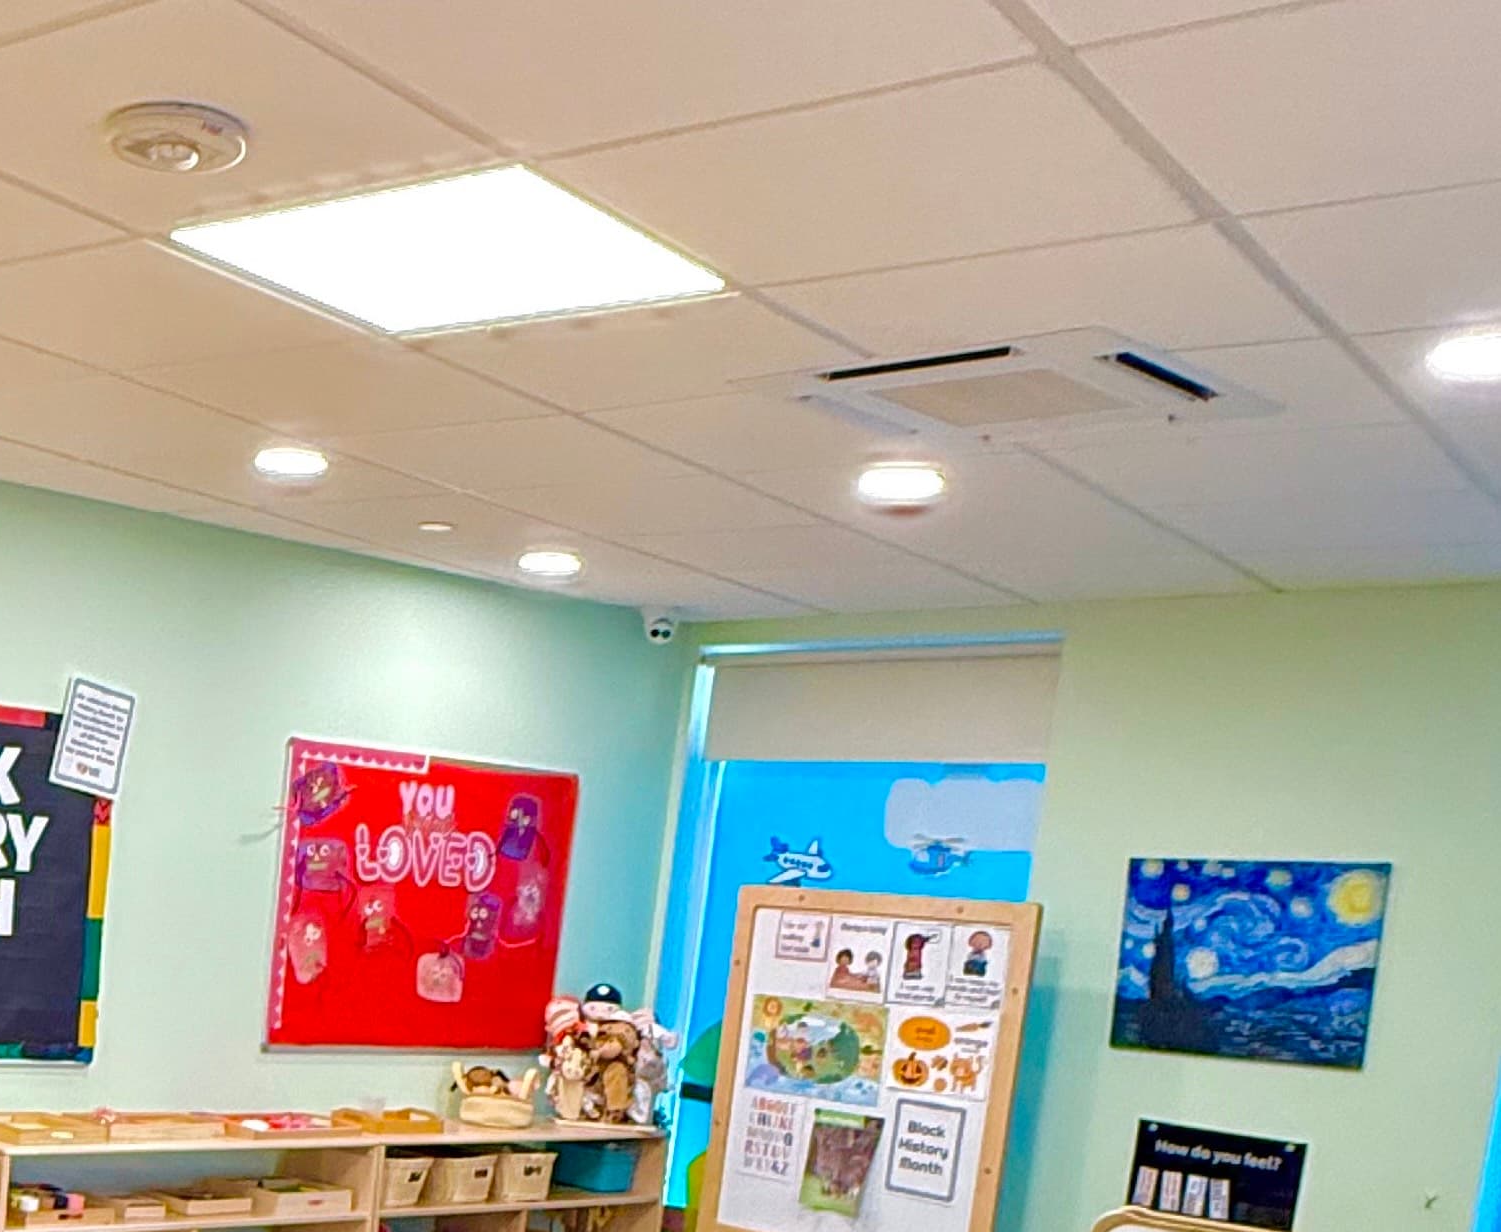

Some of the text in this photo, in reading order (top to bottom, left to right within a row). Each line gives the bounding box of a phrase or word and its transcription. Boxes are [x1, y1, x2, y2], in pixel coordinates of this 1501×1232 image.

[400, 781, 455, 818] YOU
[355, 823, 496, 892] LOVED
[907, 1120, 946, 1138] Black
[898, 1137, 949, 1160] History
[1154, 1139, 1283, 1171] How do you feel?
[899, 1157, 943, 1176] Month
